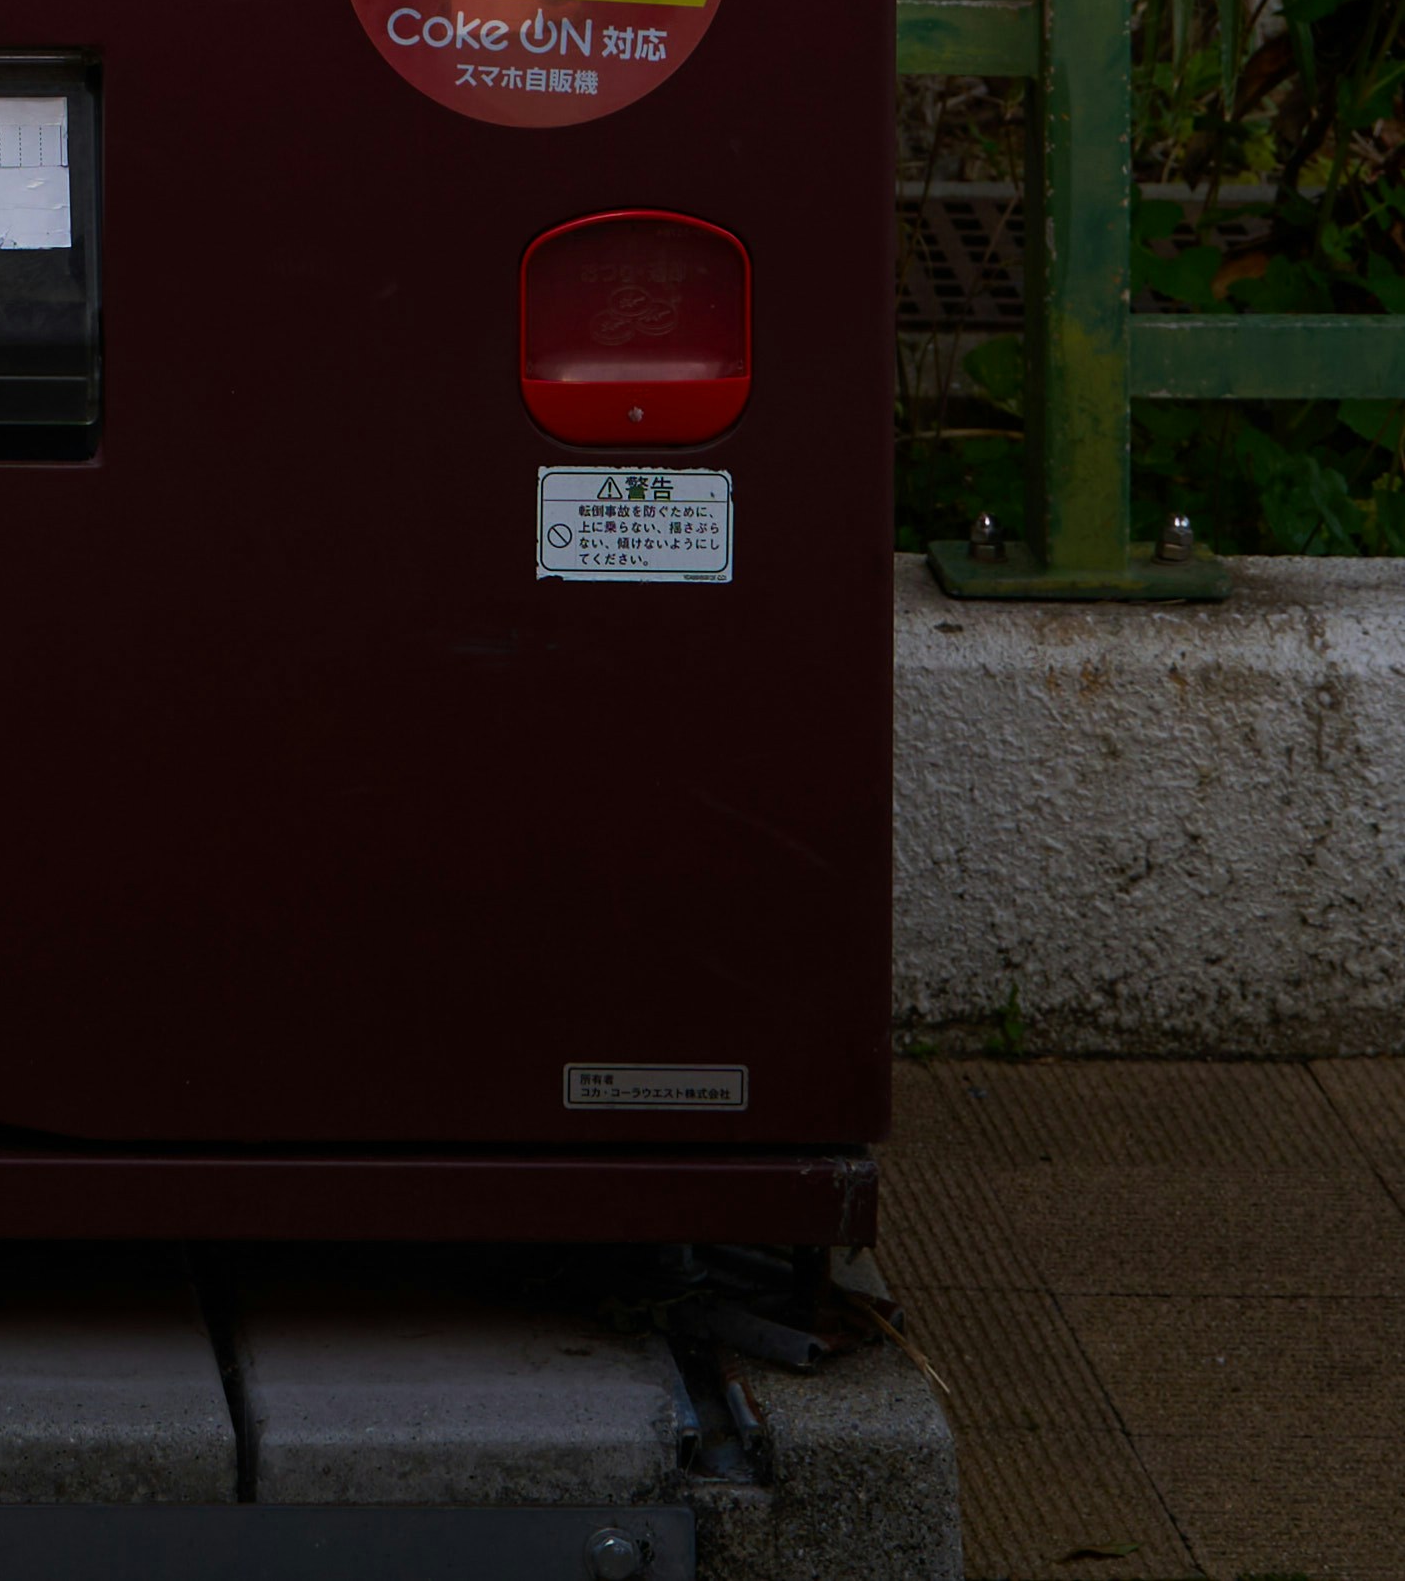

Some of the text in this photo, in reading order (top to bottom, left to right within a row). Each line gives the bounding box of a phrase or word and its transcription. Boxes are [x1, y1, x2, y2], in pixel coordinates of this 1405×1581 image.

[455, 64, 598, 94] スマホ自販機
[579, 505, 714, 518] 転倒事故を防ぐために、
[580, 554, 649, 566] てください。
[581, 1088, 730, 1100] コカ・コーラウエスト株式会社
